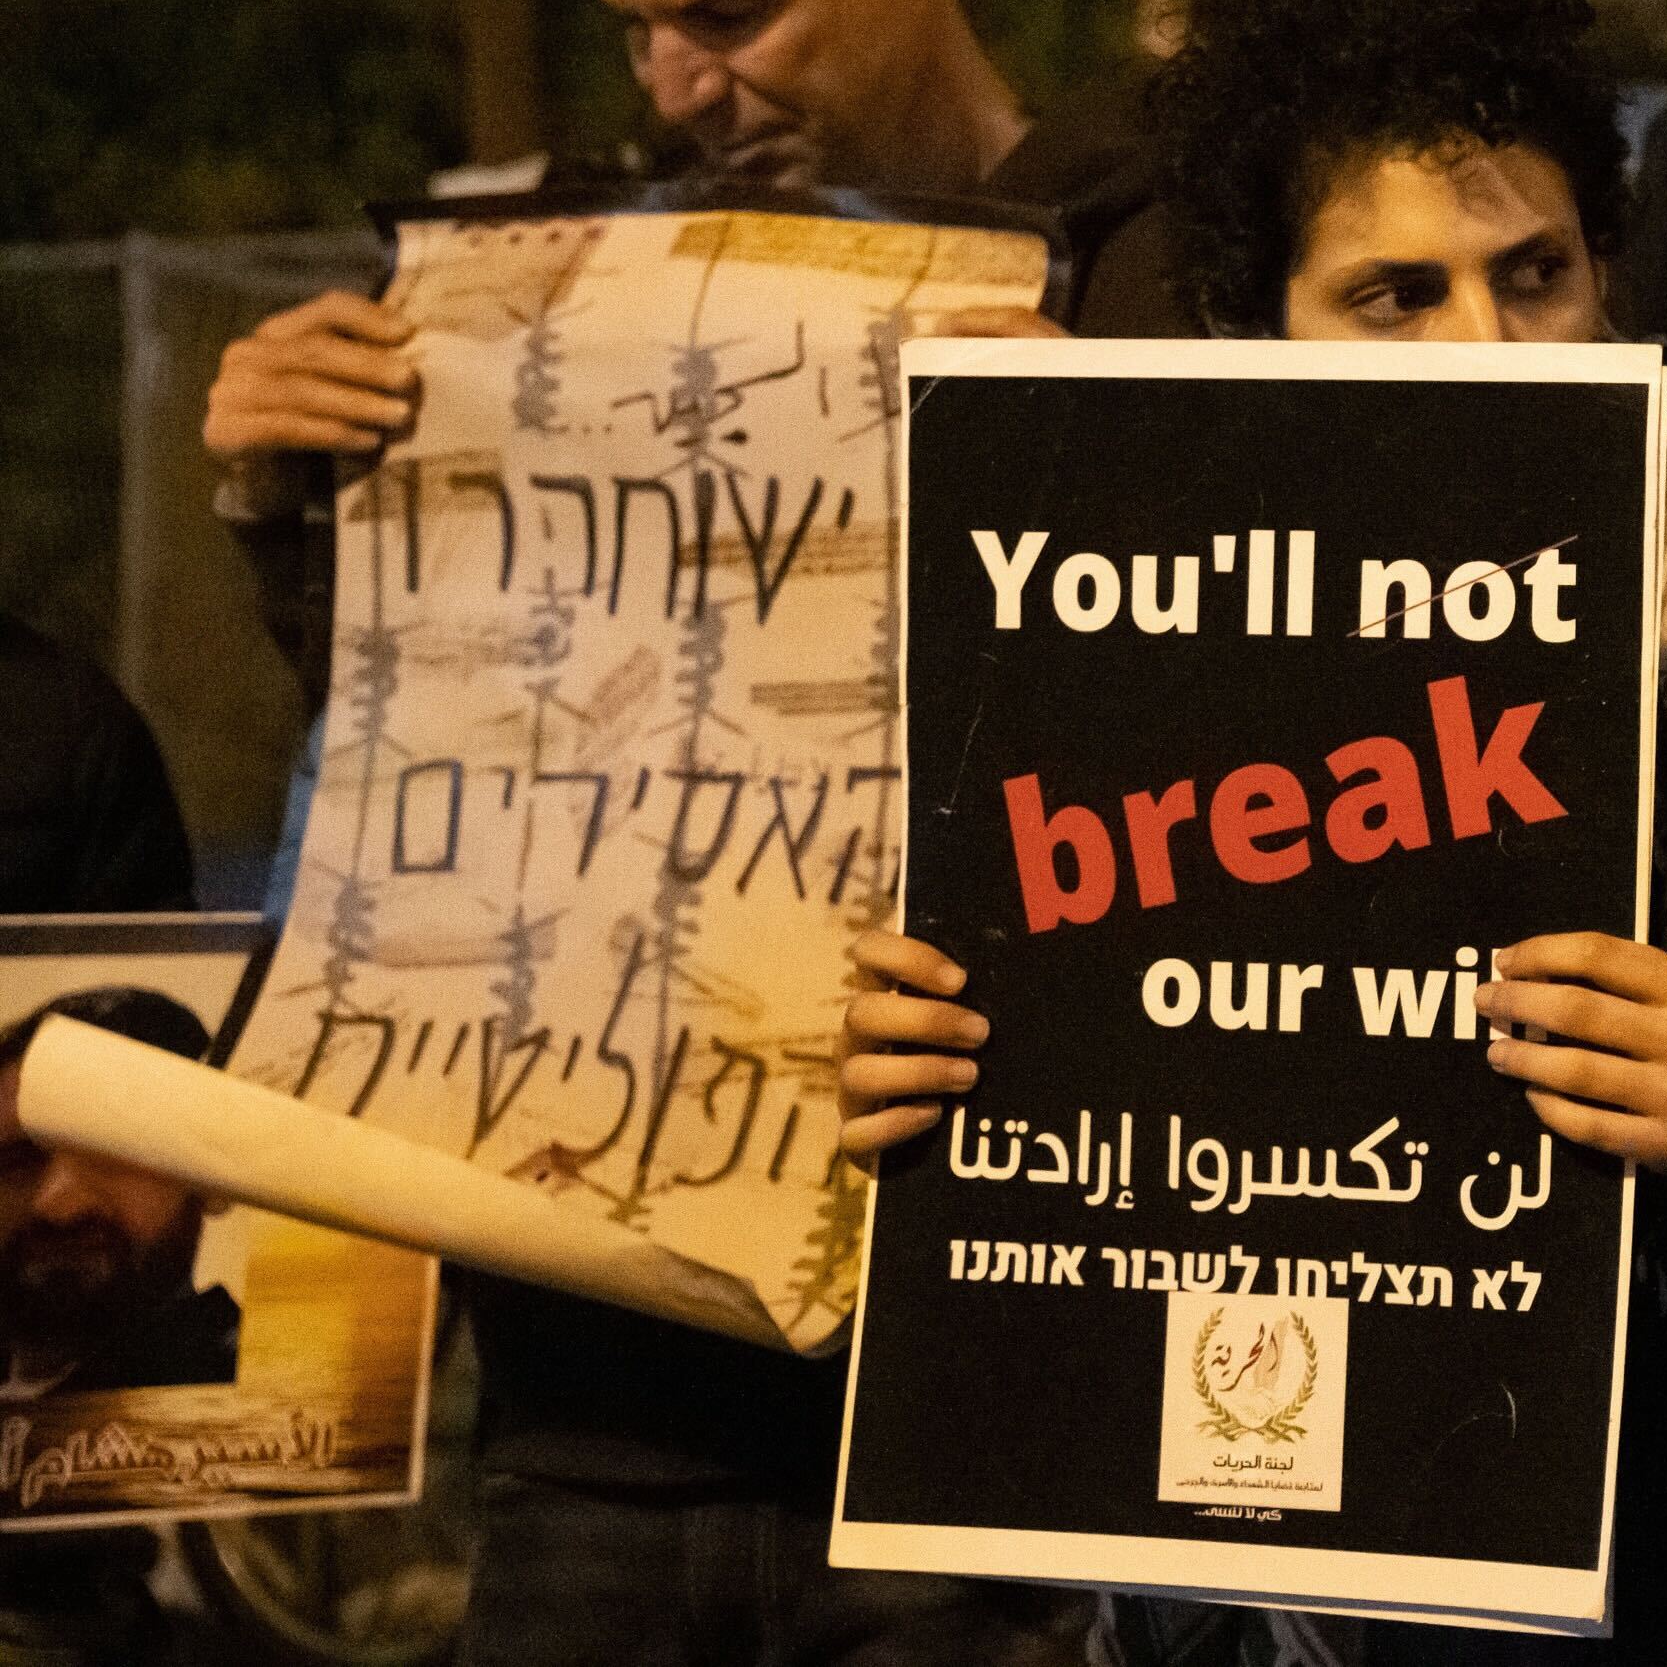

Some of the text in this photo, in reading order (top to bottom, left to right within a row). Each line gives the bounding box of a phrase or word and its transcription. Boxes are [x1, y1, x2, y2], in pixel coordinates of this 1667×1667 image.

[970, 529, 1577, 645] You'll not
[1002, 675, 1570, 934] break
[1141, 957, 1324, 1033] our
[949, 1106, 1554, 1231] لن تكسروا إرادتنا
[949, 1238, 1087, 1286] אותנו
[1101, 1244, 1261, 1295] לשבור
[1471, 1260, 1542, 1312] לא
[1212, 1454, 1294, 1475] لجنة الحريات
